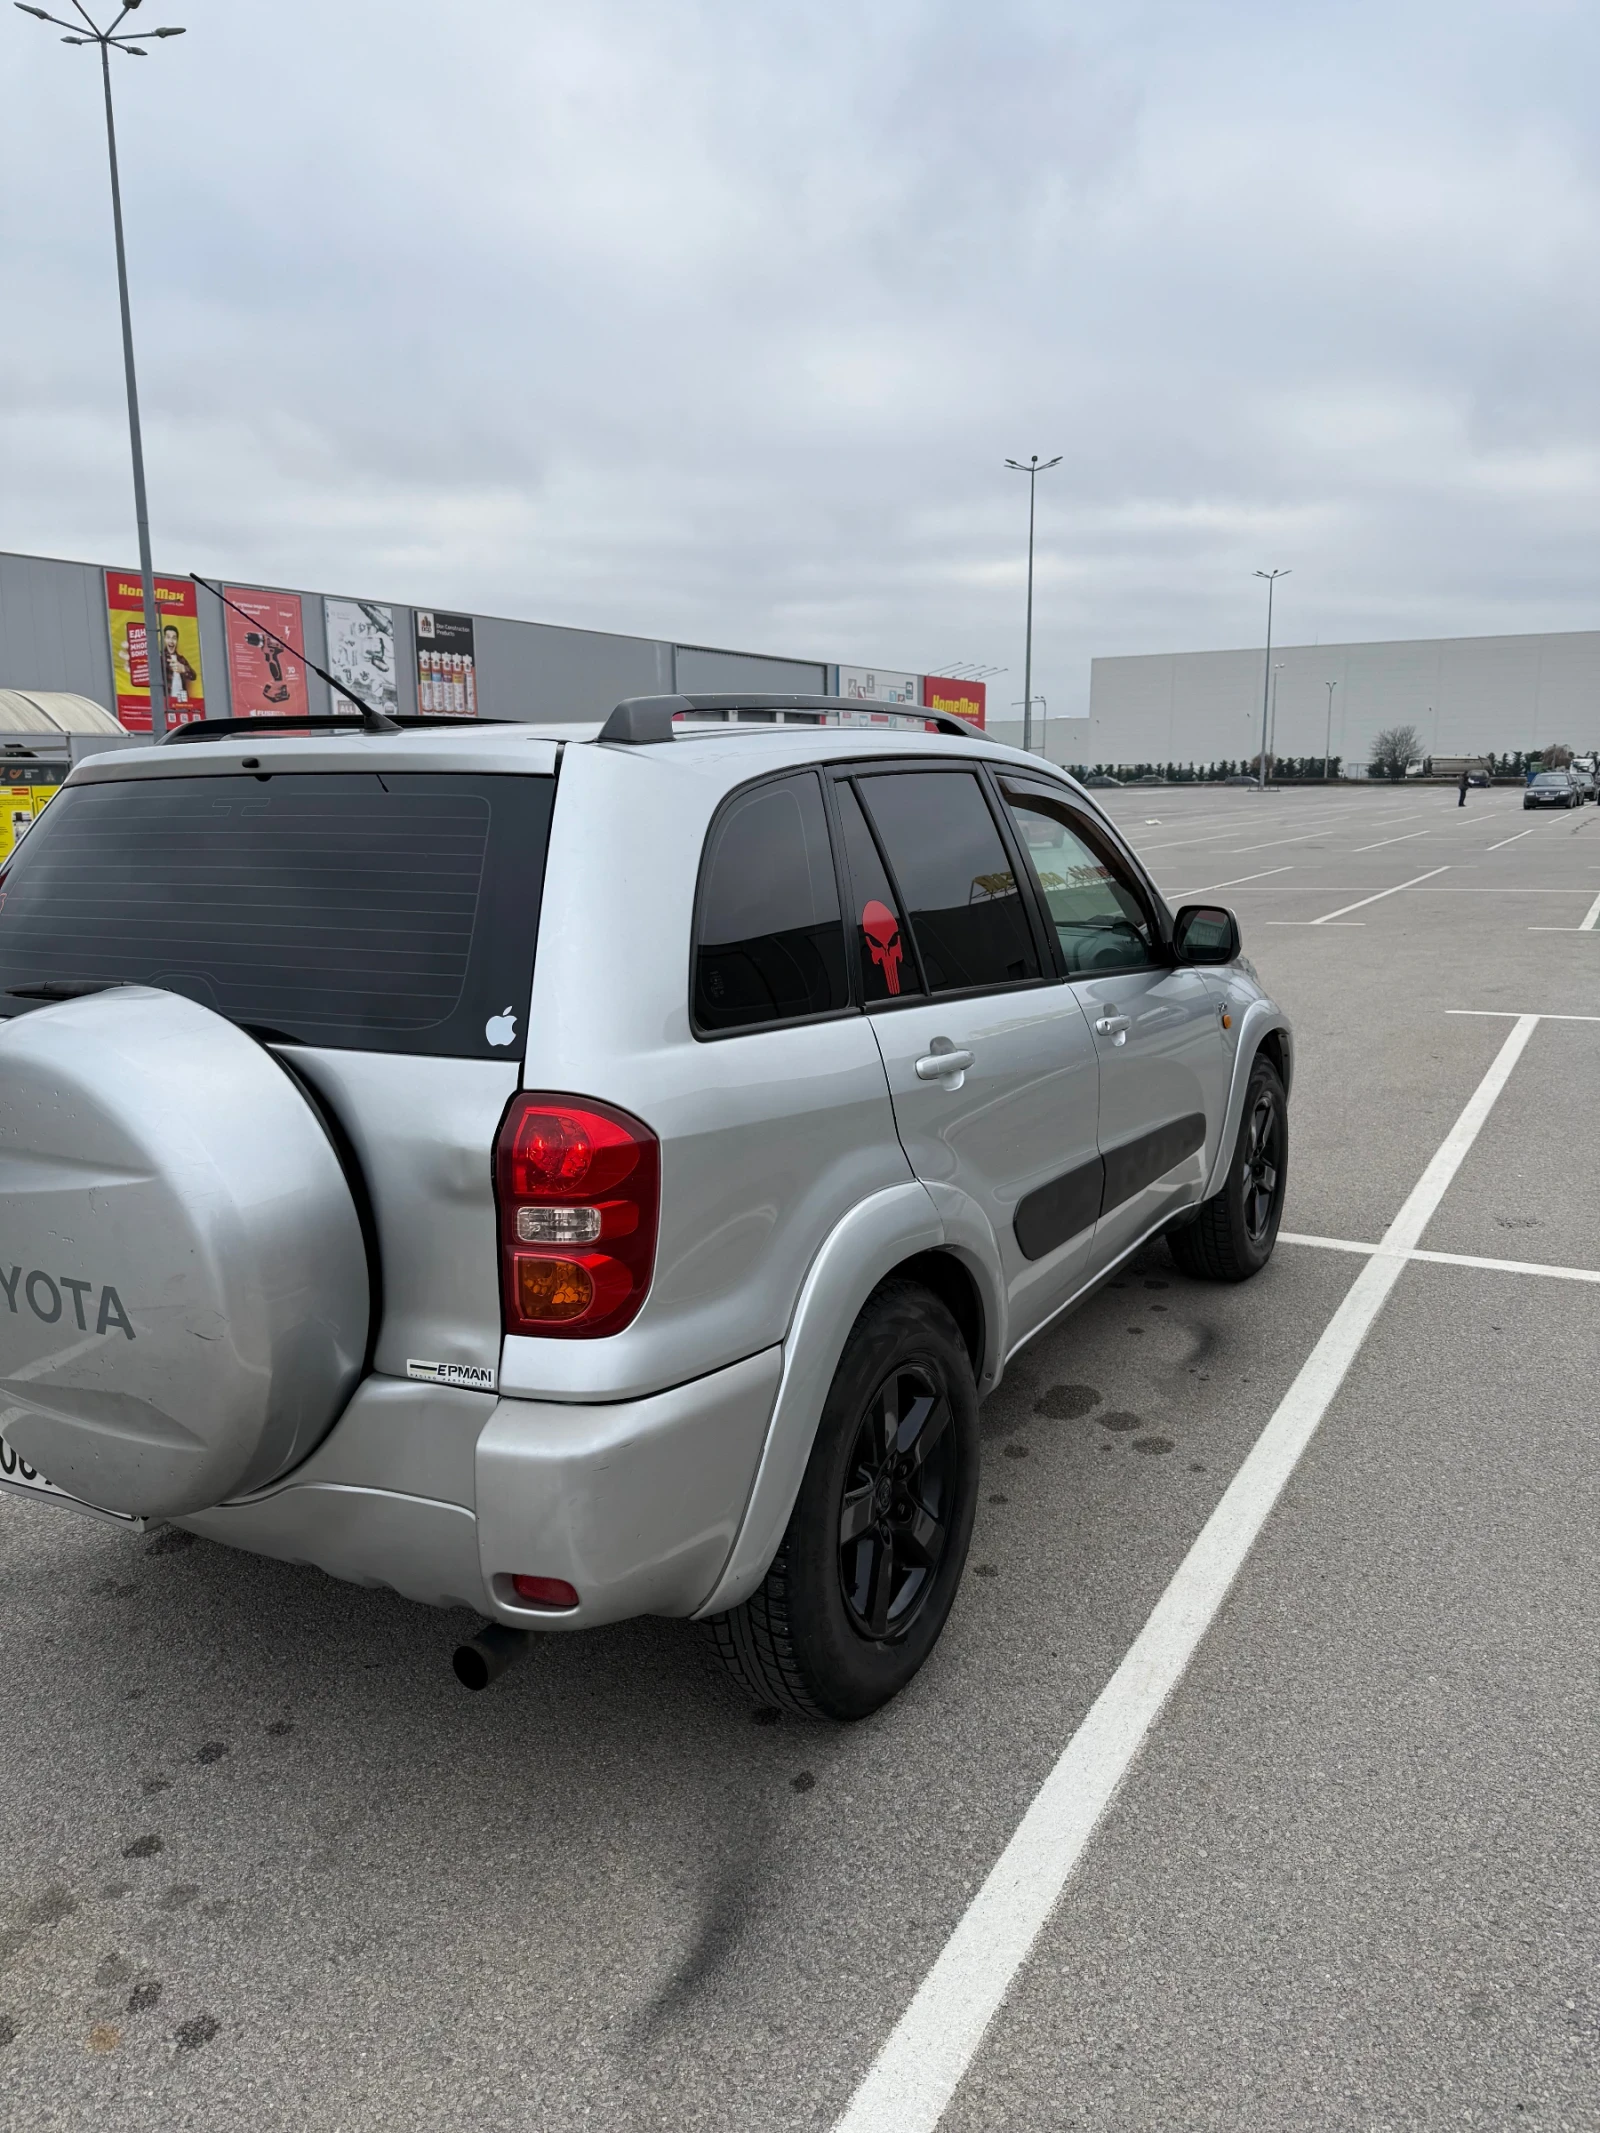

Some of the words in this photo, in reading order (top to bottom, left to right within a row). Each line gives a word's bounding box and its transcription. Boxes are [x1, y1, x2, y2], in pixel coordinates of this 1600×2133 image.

[118, 583, 184, 601] HomMax
[129, 628, 147, 639] ЕДН
[444, 624, 470, 633] Construction
[933, 694, 980, 715] HomeMax
[437, 1364, 492, 1383] EPMAN
